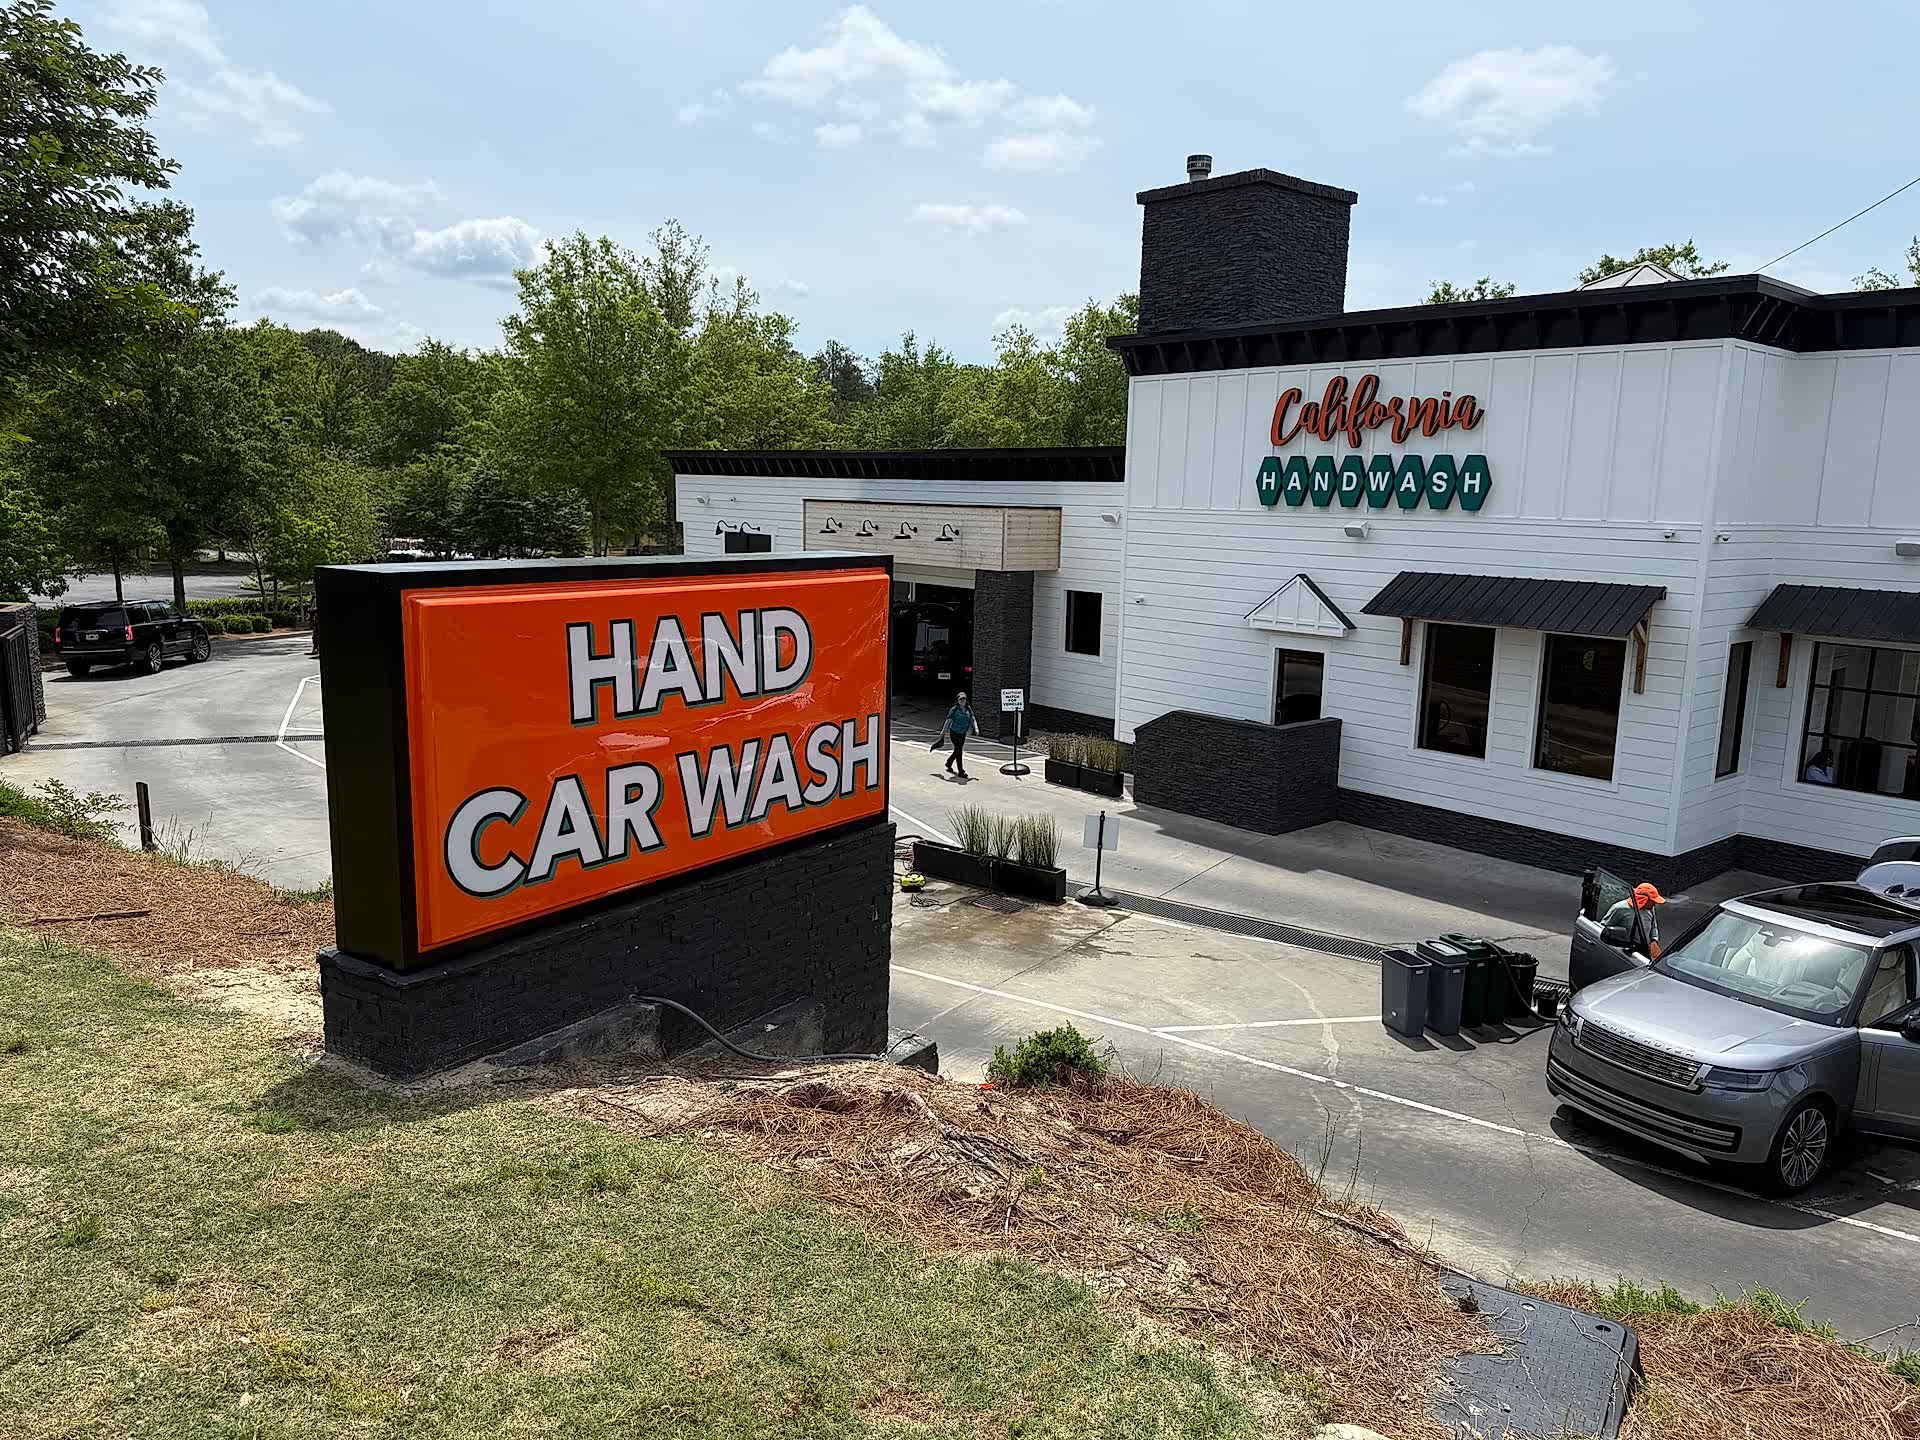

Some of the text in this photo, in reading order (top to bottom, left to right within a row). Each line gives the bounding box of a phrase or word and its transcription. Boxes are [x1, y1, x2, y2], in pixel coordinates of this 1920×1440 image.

[1271, 374, 1485, 448] California
[1261, 470, 1482, 494] HANDWASH
[567, 607, 813, 726] HAND
[446, 713, 881, 899] CAR WASH
